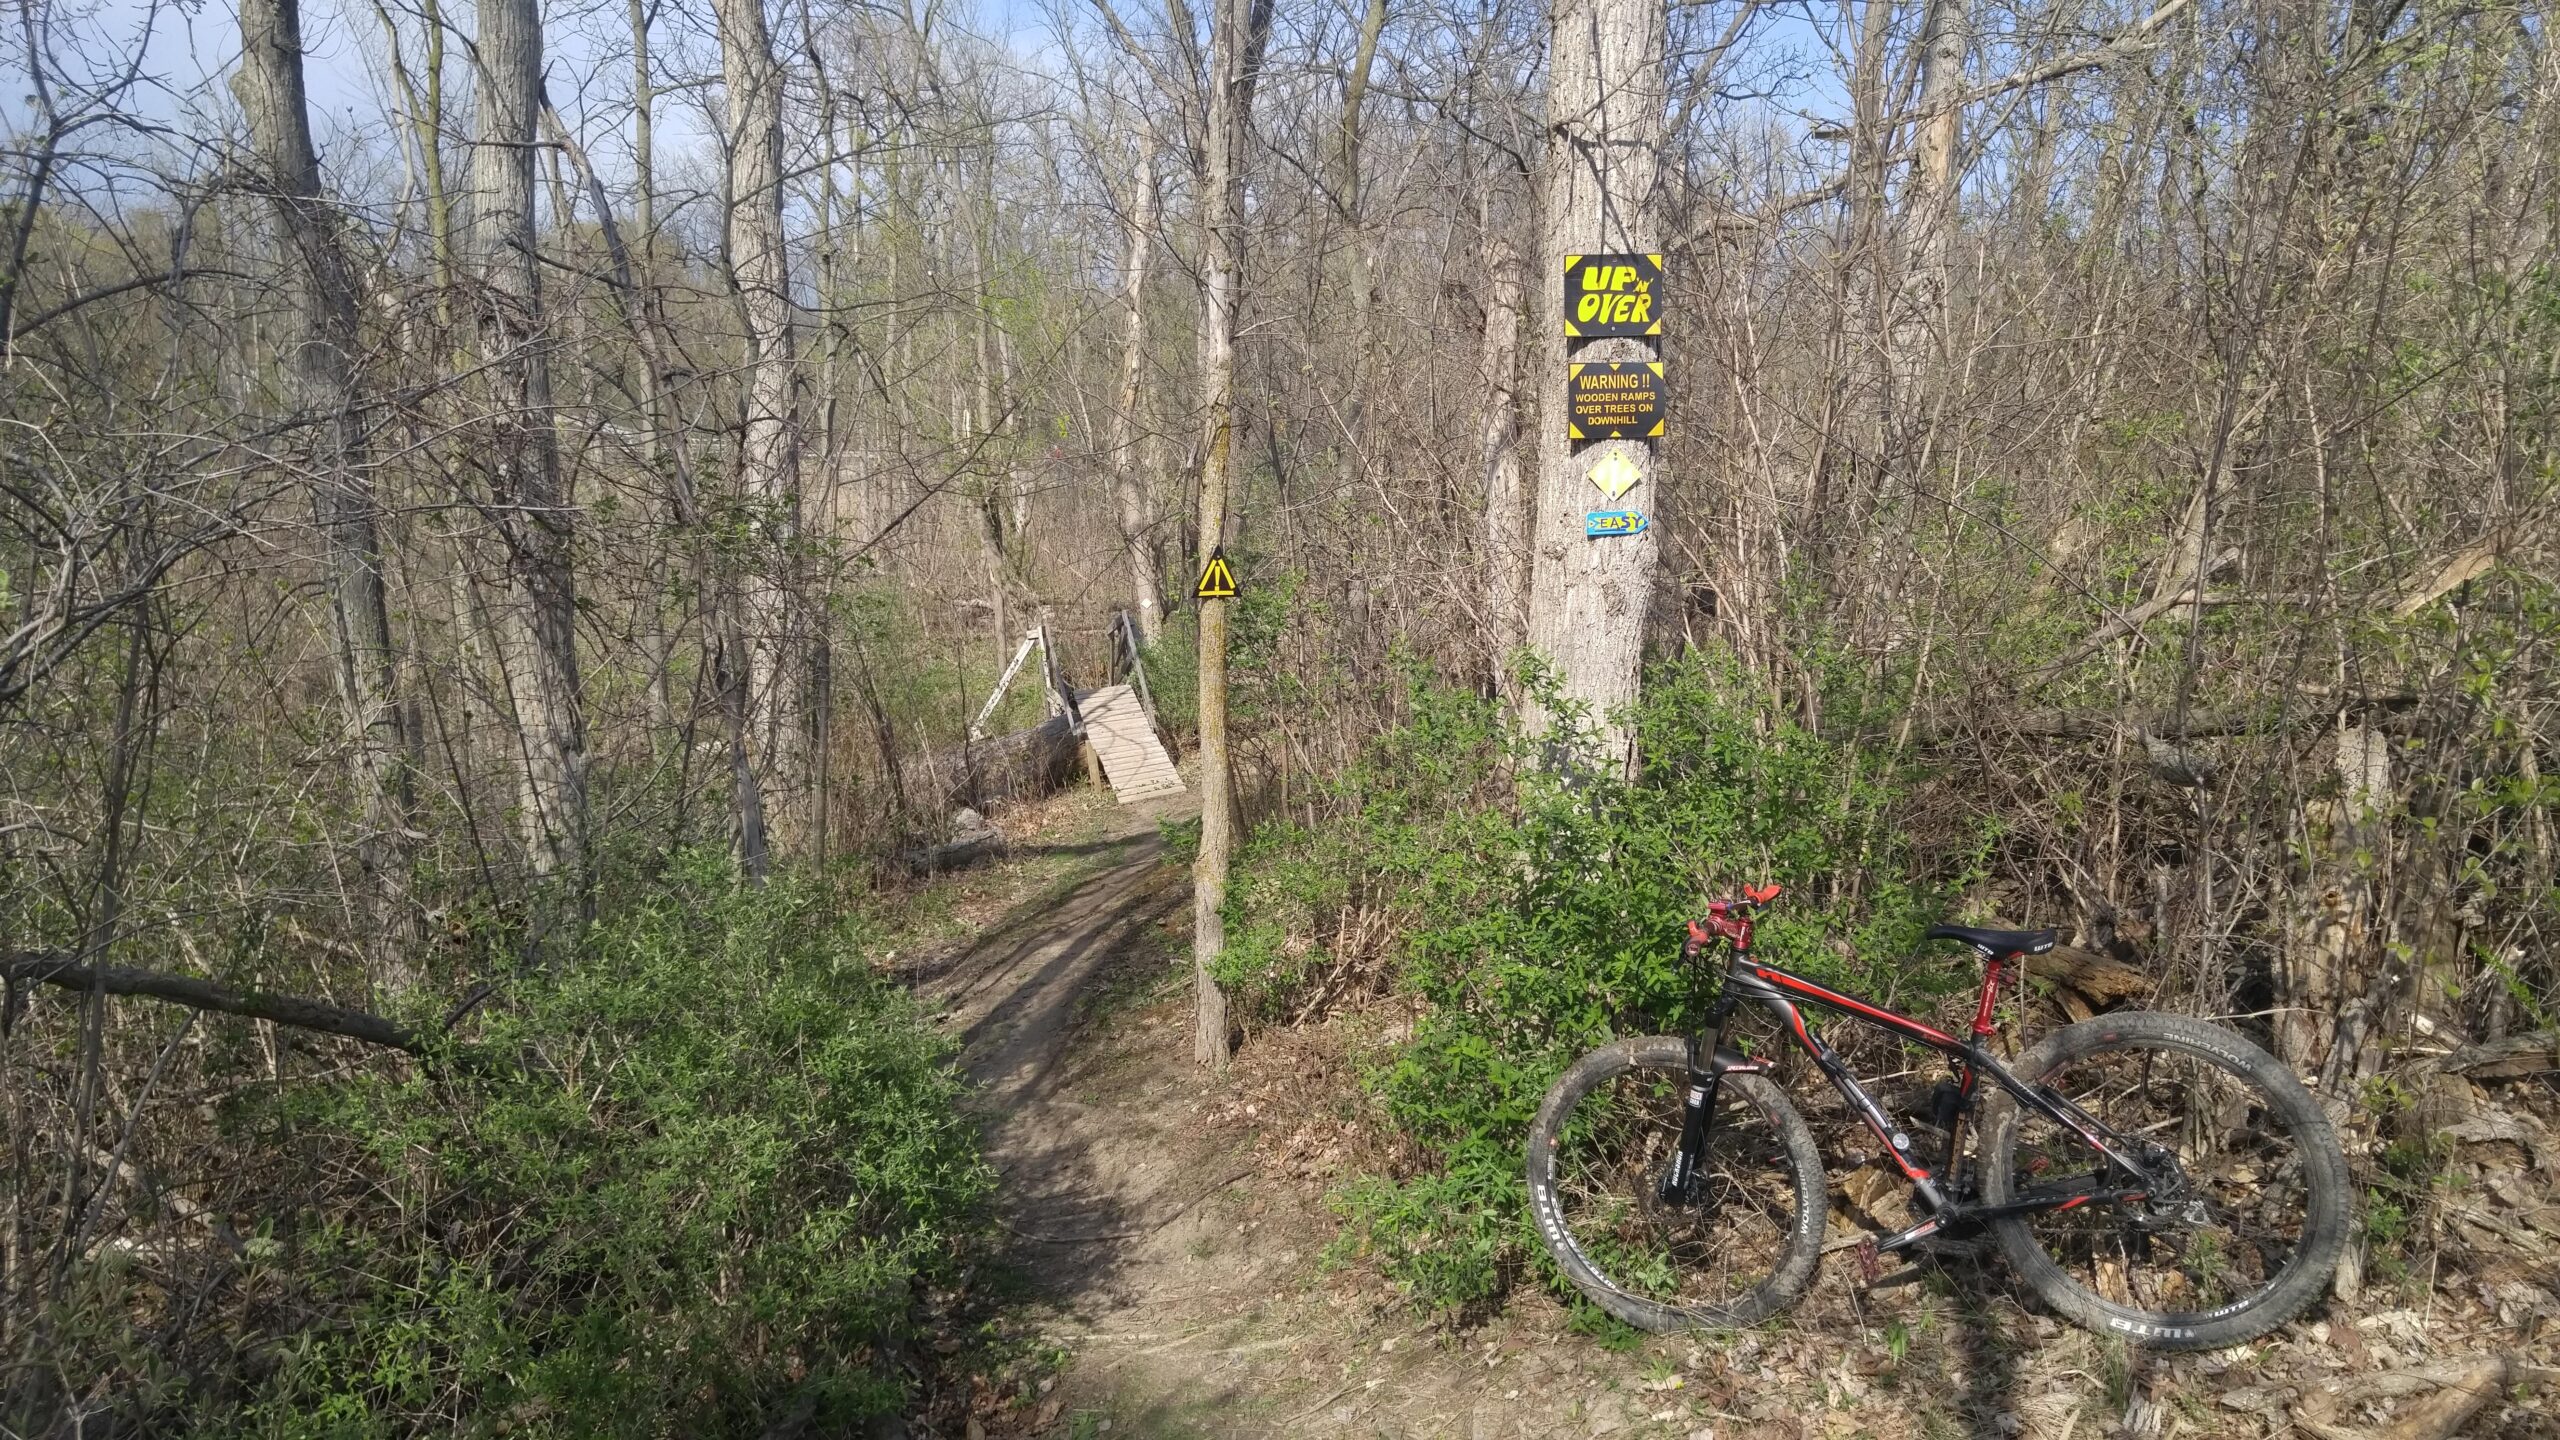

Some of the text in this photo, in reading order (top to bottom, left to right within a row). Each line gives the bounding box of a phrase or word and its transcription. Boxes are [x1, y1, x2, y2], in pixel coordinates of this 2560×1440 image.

[1582, 266, 1637, 291] UP
[1577, 293, 1652, 325] OVER
[1580, 374, 1638, 390] WARNING
[1575, 391, 1656, 402] WOODEN RAMPS
[1575, 403, 1653, 414] OVER TREES ON
[1588, 416, 1638, 425] DOWNHILL
[1600, 516, 1641, 529] EASY
[2034, 942, 2054, 952] WTB
[2163, 1032, 2252, 1072] WOLVERINE
[1795, 1159, 1810, 1236] WOLVERINE
[1537, 1184, 1561, 1241] WTB
[2110, 1317, 2182, 1339] WTB
